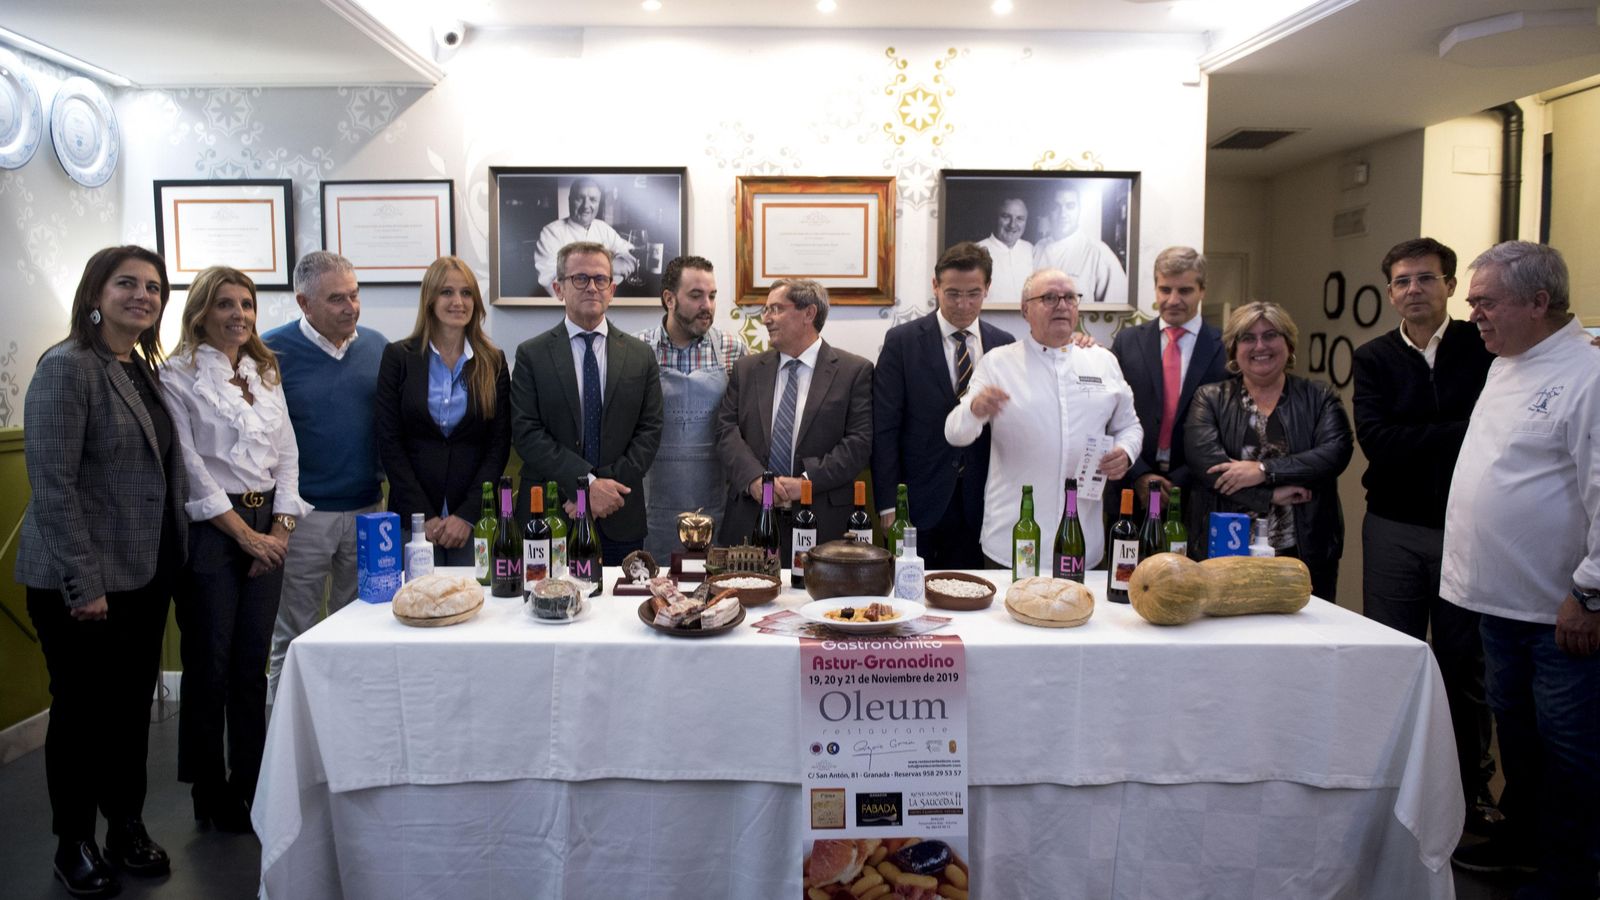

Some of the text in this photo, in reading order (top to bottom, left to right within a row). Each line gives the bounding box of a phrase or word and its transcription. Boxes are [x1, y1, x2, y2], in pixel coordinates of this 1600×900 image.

[379, 521, 392, 552] S
[796, 532, 812, 546] Ars
[1227, 521, 1242, 550] S
[528, 544, 544, 559] Ars
[1120, 543, 1136, 559] Ars
[496, 559, 522, 577] EM
[568, 560, 592, 577] EM
[1060, 556, 1084, 573] EM
[821, 640, 943, 651] Gastronómico
[812, 654, 955, 671] Astur-Granadino
[809, 672, 959, 687] 19, 20 y 21 de Noviembre de 2019
[819, 690, 949, 722] Oleum
[822, 726, 949, 736] restaurante
[816, 771, 828, 779] San
[829, 770, 850, 779] Antón,
[863, 770, 890, 778] Granada
[894, 770, 922, 778] Reservas
[861, 803, 897, 815] FABADA
